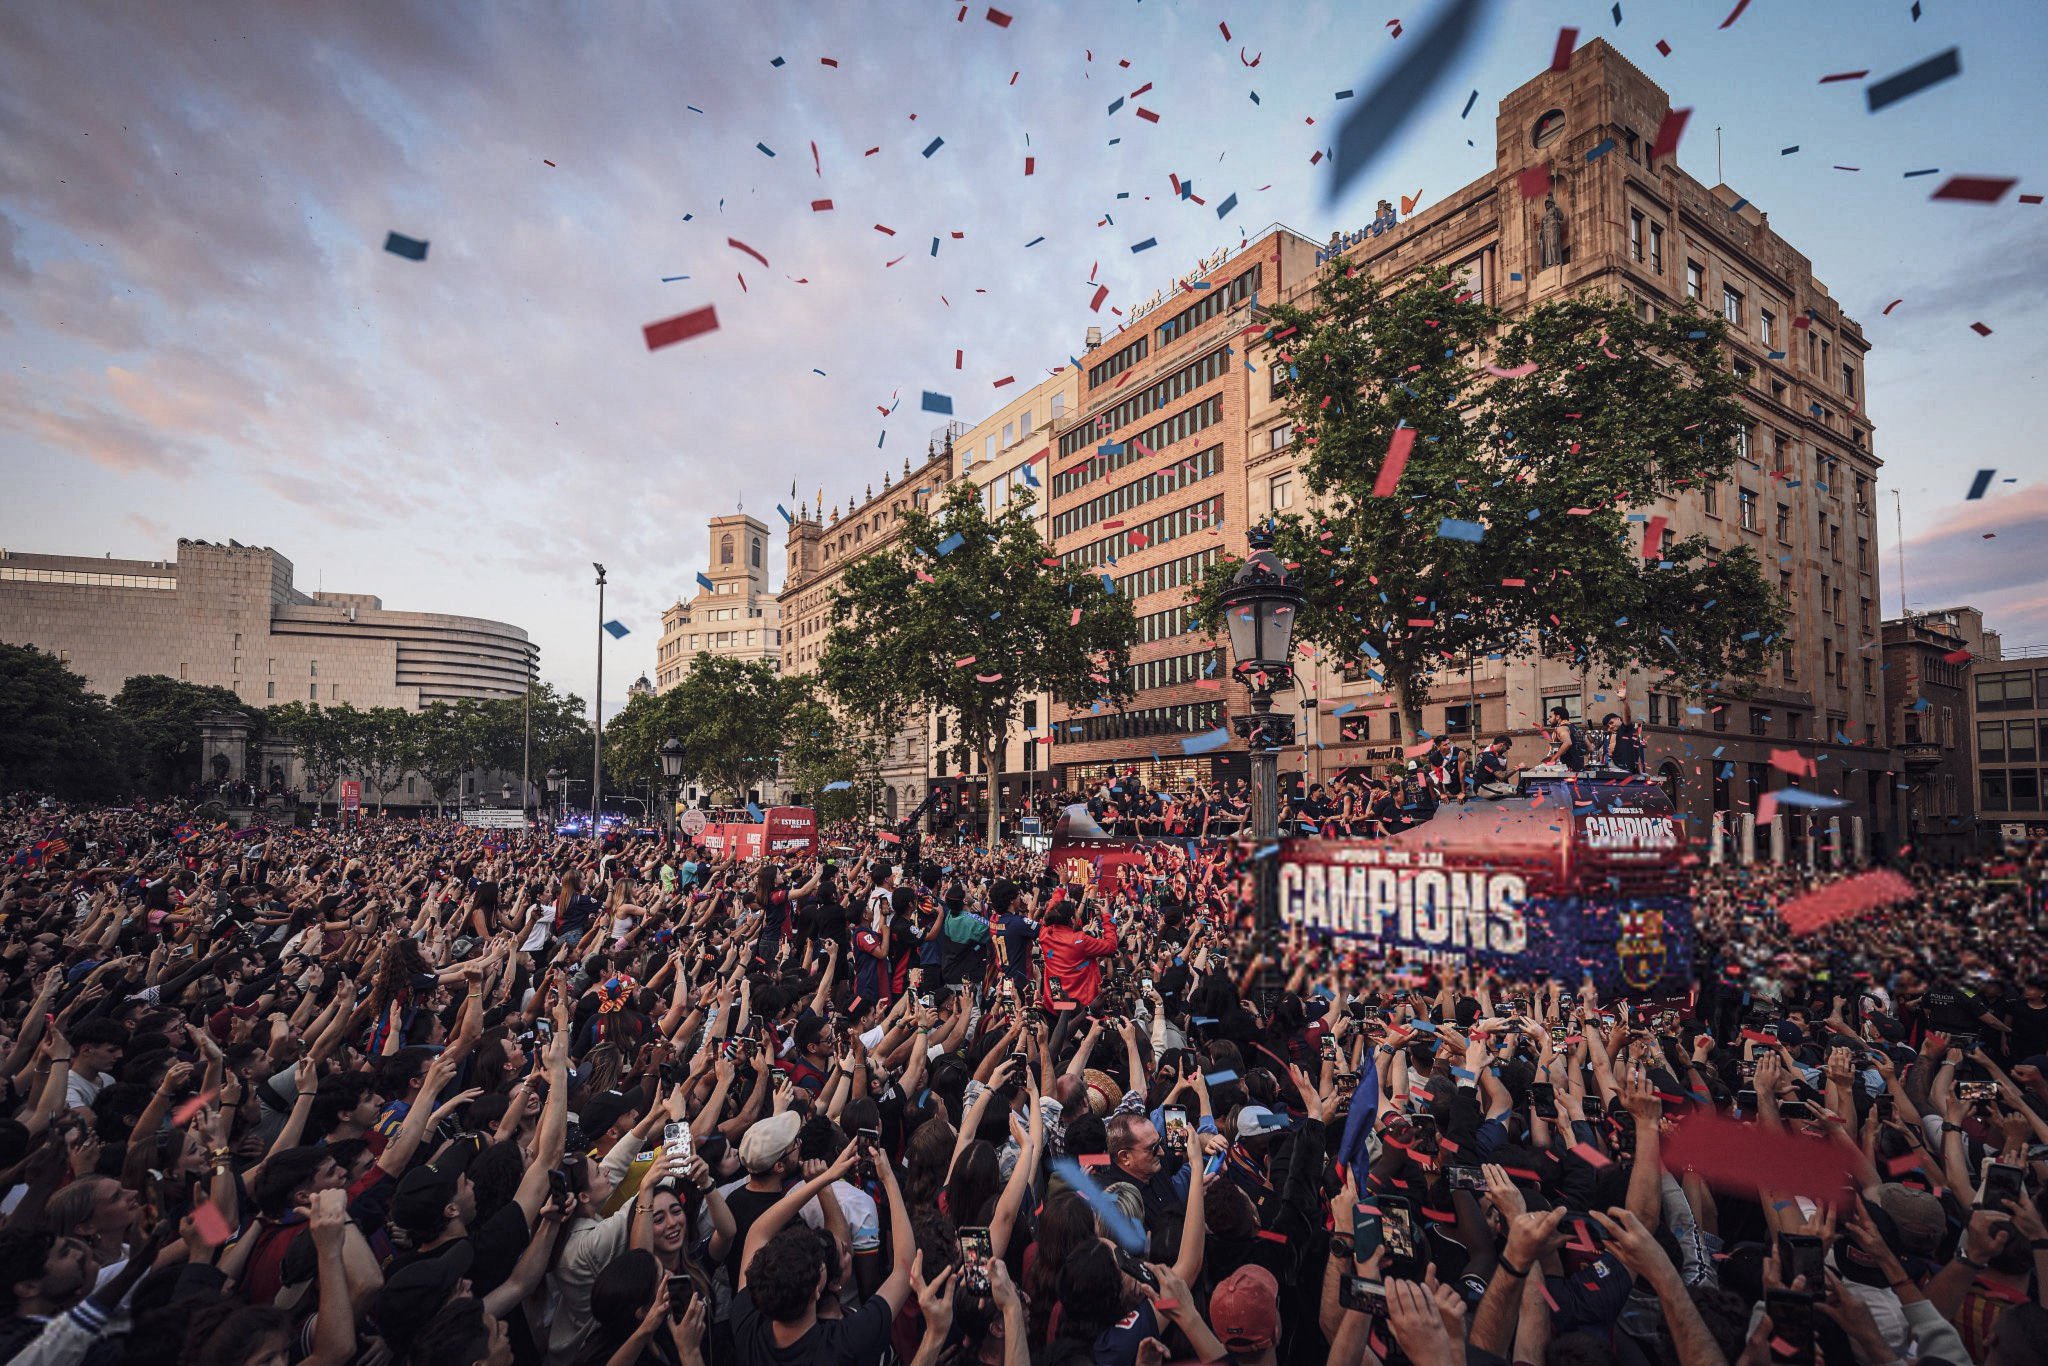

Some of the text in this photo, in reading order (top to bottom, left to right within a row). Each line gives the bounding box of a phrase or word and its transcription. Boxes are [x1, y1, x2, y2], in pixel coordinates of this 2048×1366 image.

[1315, 208, 1397, 267] Naturgy
[1366, 747, 1393, 760] Hard
[1585, 816, 1677, 848] CAMPIONS
[1279, 862, 1527, 954] CAMPIONS
